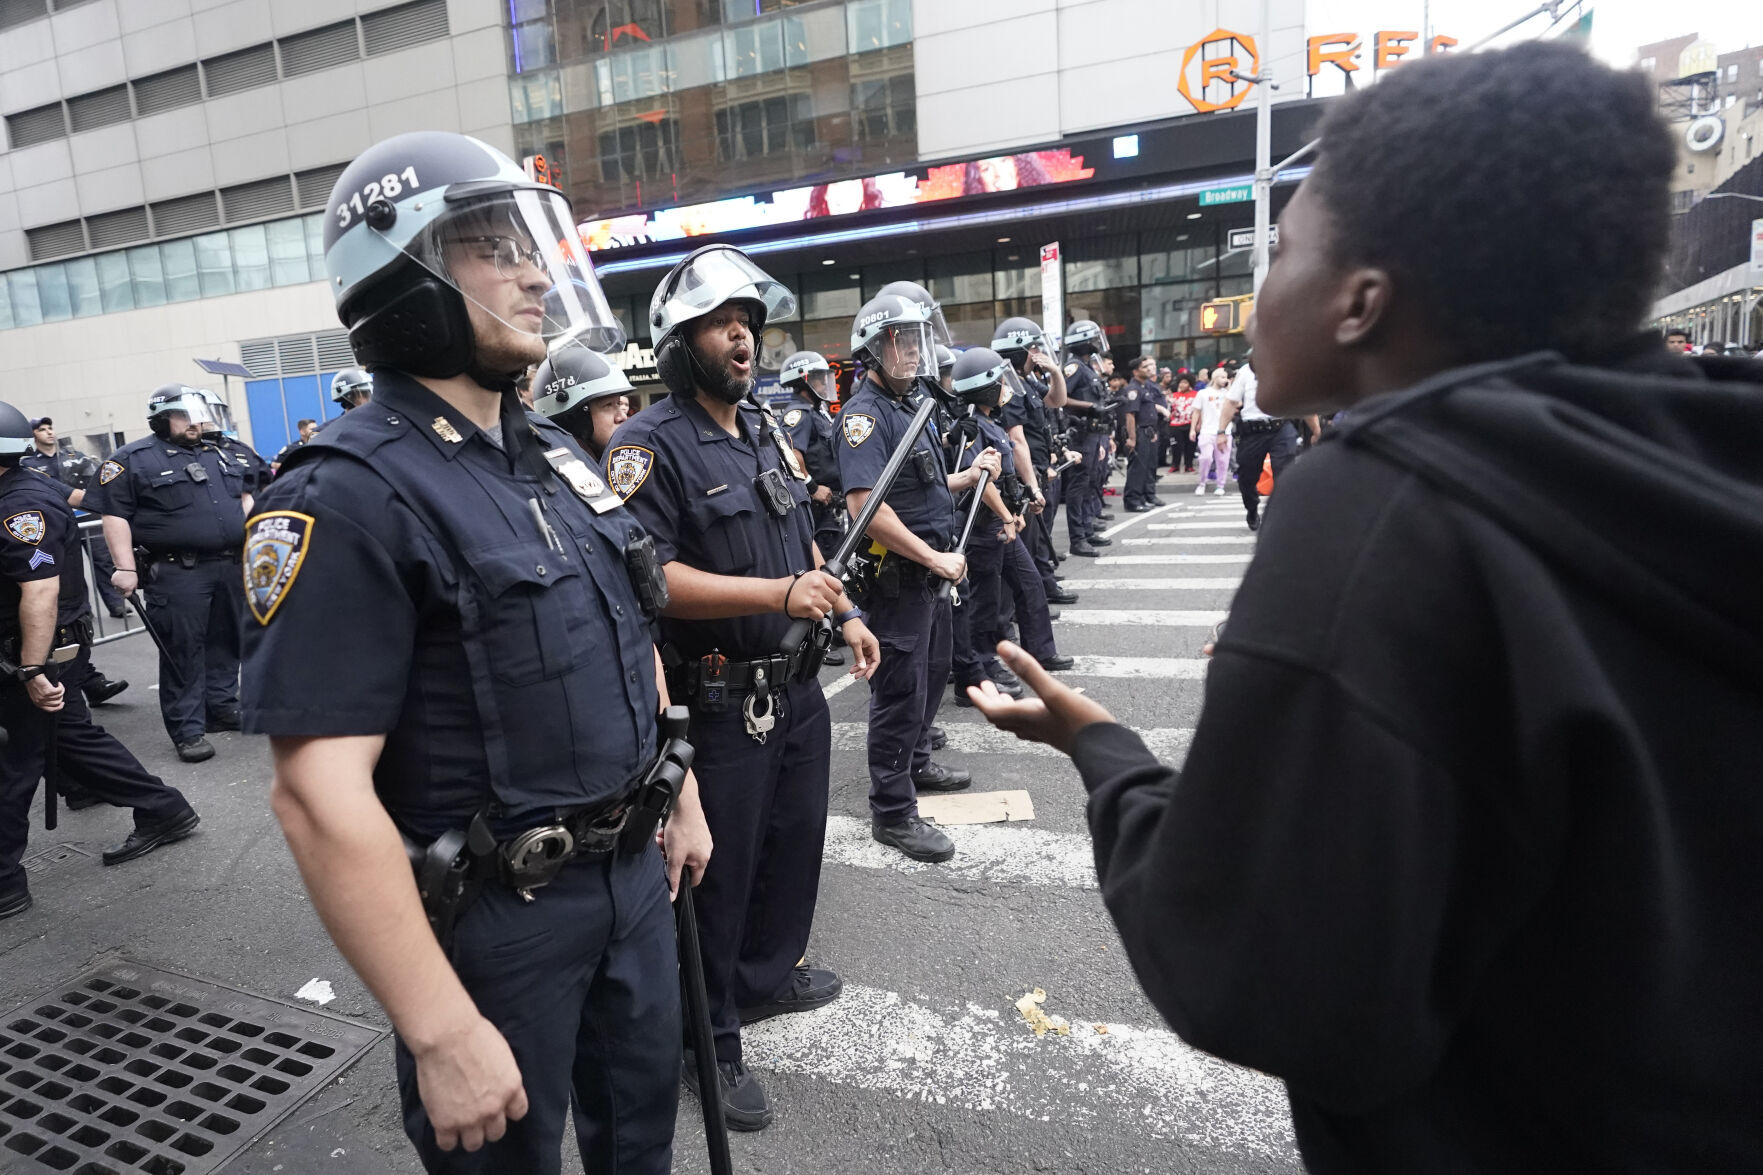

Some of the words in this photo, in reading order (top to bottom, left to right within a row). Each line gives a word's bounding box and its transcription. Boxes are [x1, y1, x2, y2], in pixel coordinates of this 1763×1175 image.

[1202, 57, 1239, 87] R
[336, 166, 420, 228] 31281
[1205, 189, 1249, 203] Broadway
[860, 310, 890, 328] 20801
[612, 455, 648, 464] DEPARTMENT
